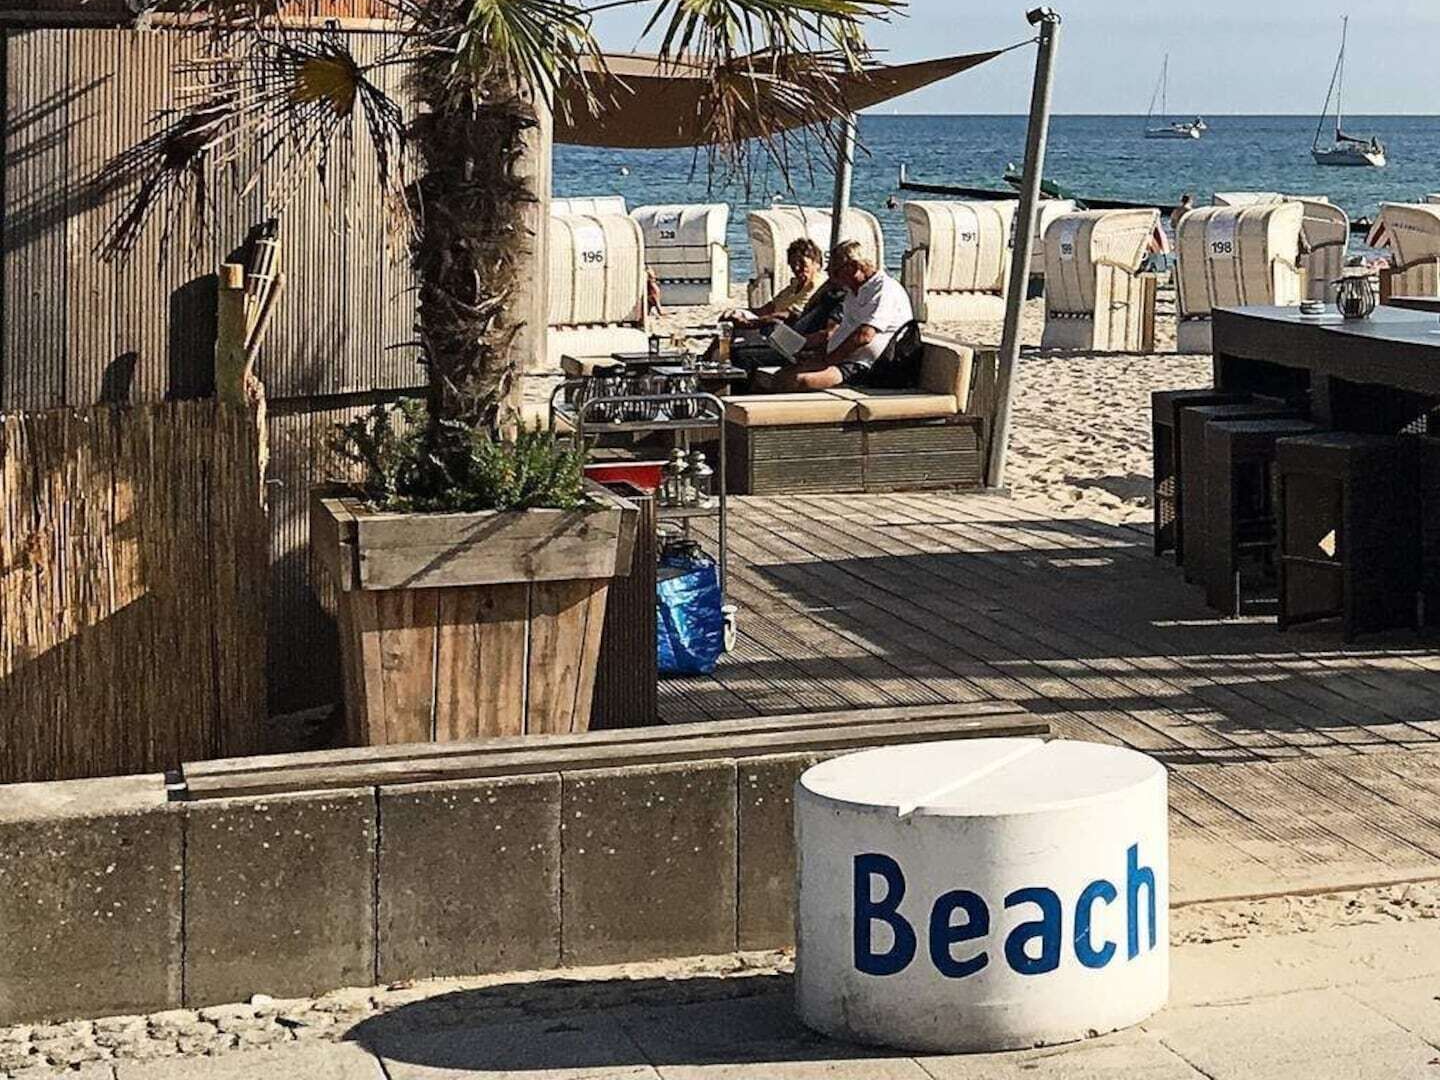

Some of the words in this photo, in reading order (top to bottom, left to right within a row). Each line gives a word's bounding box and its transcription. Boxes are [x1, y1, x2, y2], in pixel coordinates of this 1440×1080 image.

[1210, 241, 1233, 254] 198
[581, 250, 604, 263] 196
[853, 842, 1158, 979] Beach
